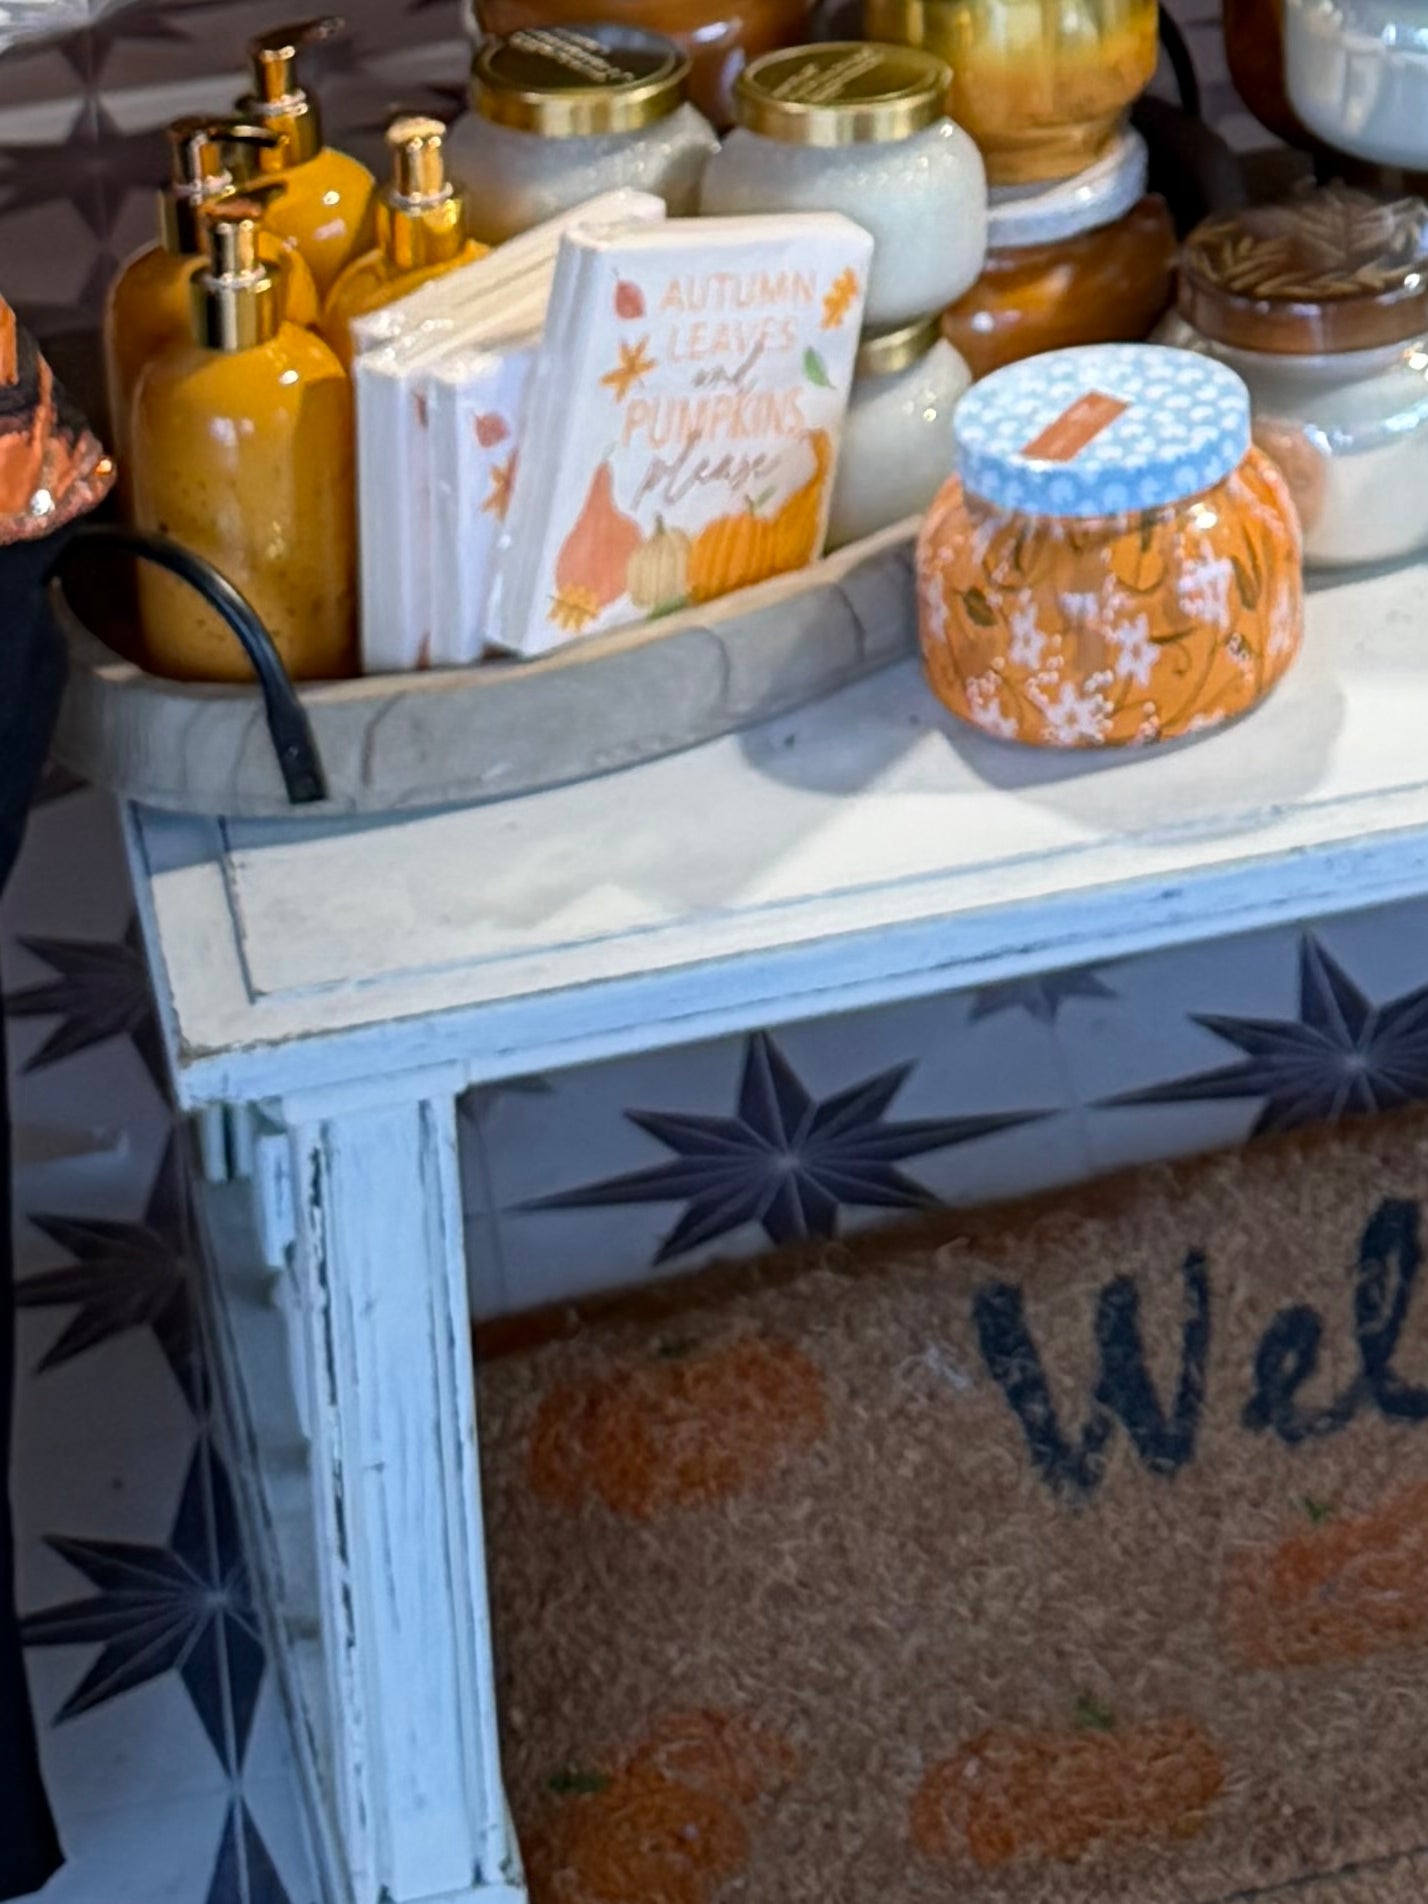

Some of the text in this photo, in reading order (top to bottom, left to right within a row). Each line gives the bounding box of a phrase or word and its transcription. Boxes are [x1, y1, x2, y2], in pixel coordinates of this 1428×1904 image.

[658, 267, 818, 313] AUTUMN
[668, 315, 796, 363] LEAVES
[620, 387, 806, 450] PUMPKINS
